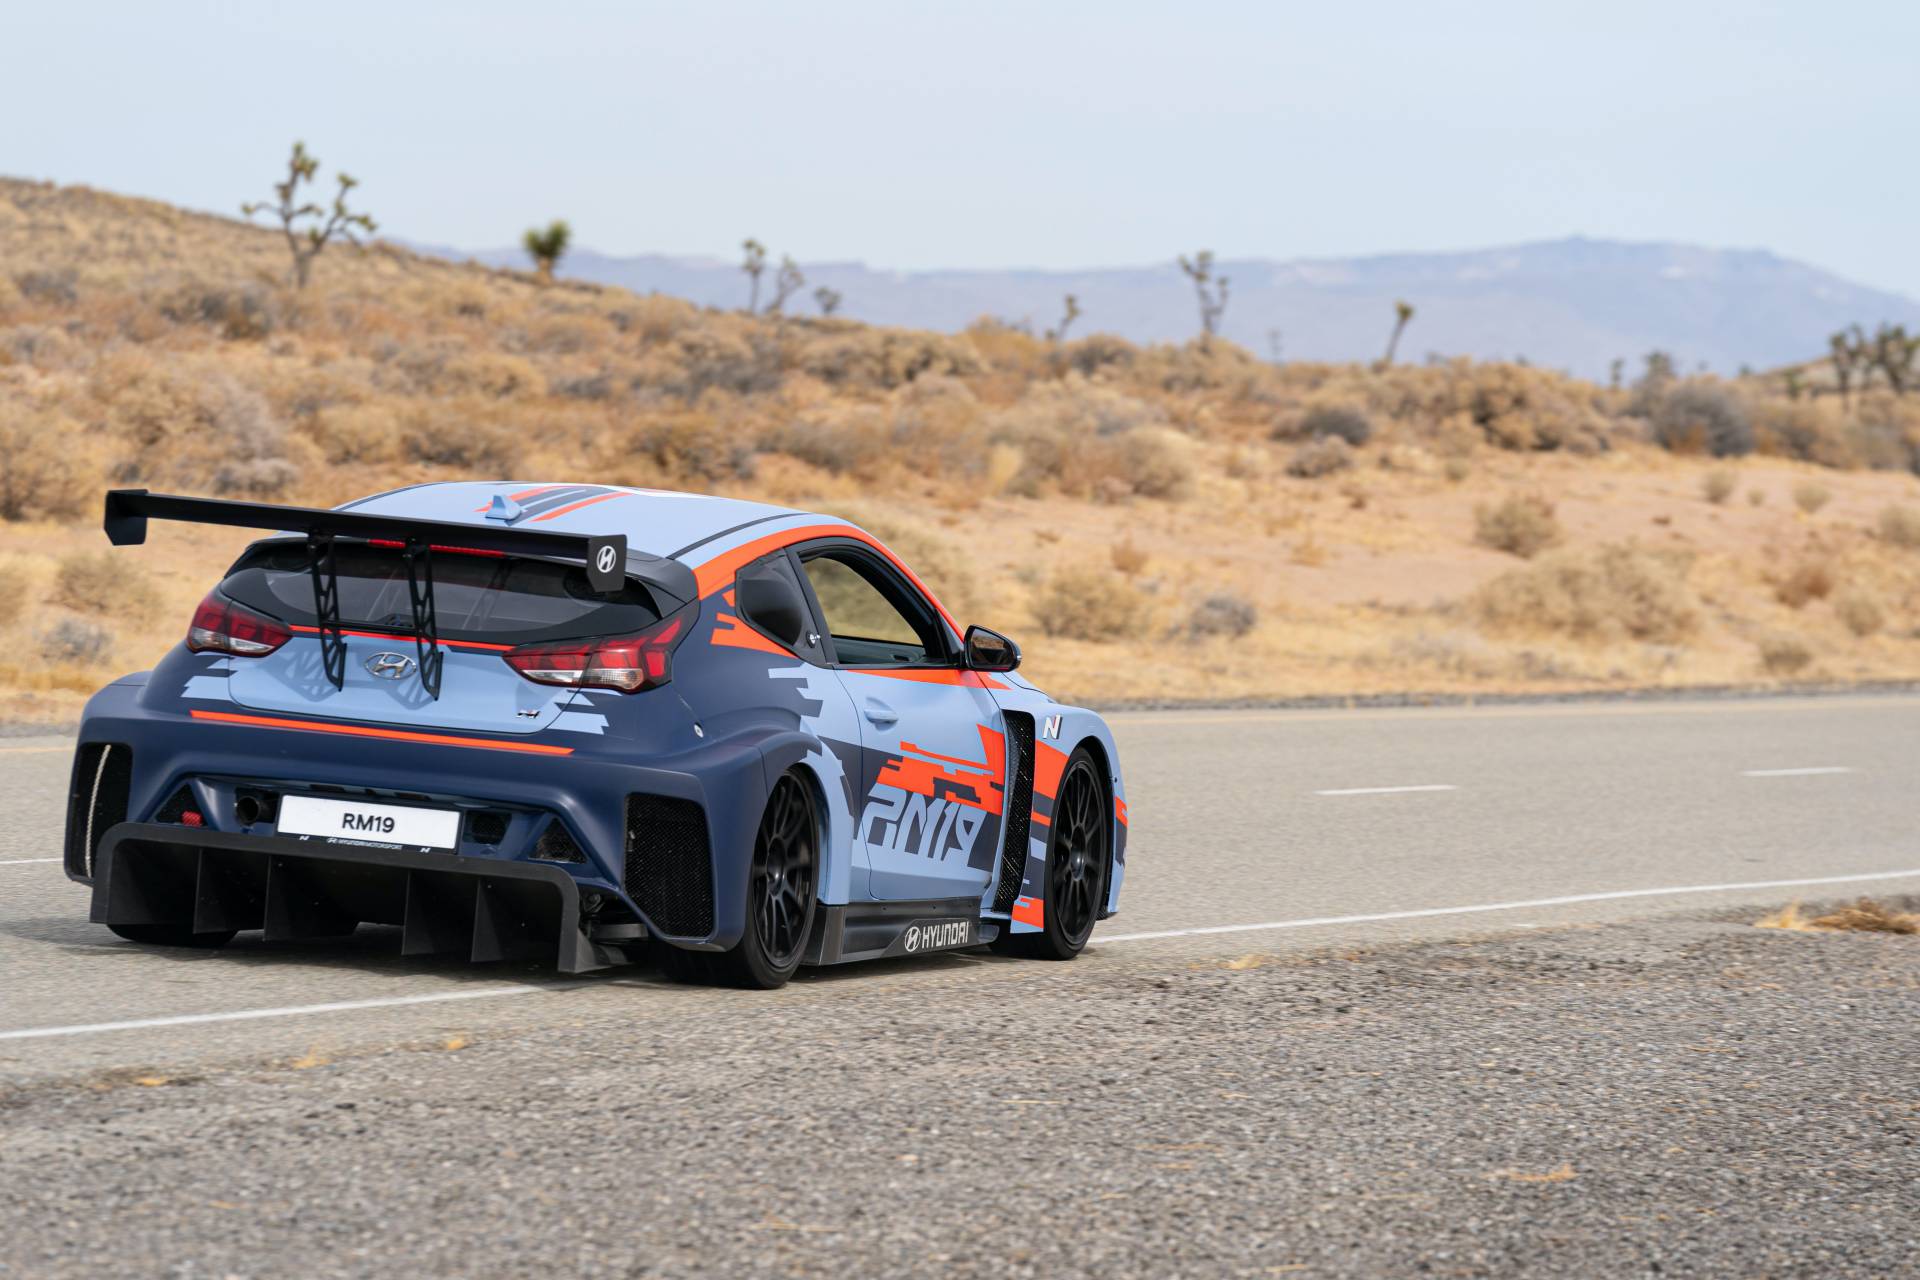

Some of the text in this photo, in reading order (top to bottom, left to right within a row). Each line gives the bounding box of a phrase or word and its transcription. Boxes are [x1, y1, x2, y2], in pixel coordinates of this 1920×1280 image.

[1042, 714, 1063, 740] N
[341, 812, 396, 834] RM19
[921, 921, 970, 949] HYUNDAI
